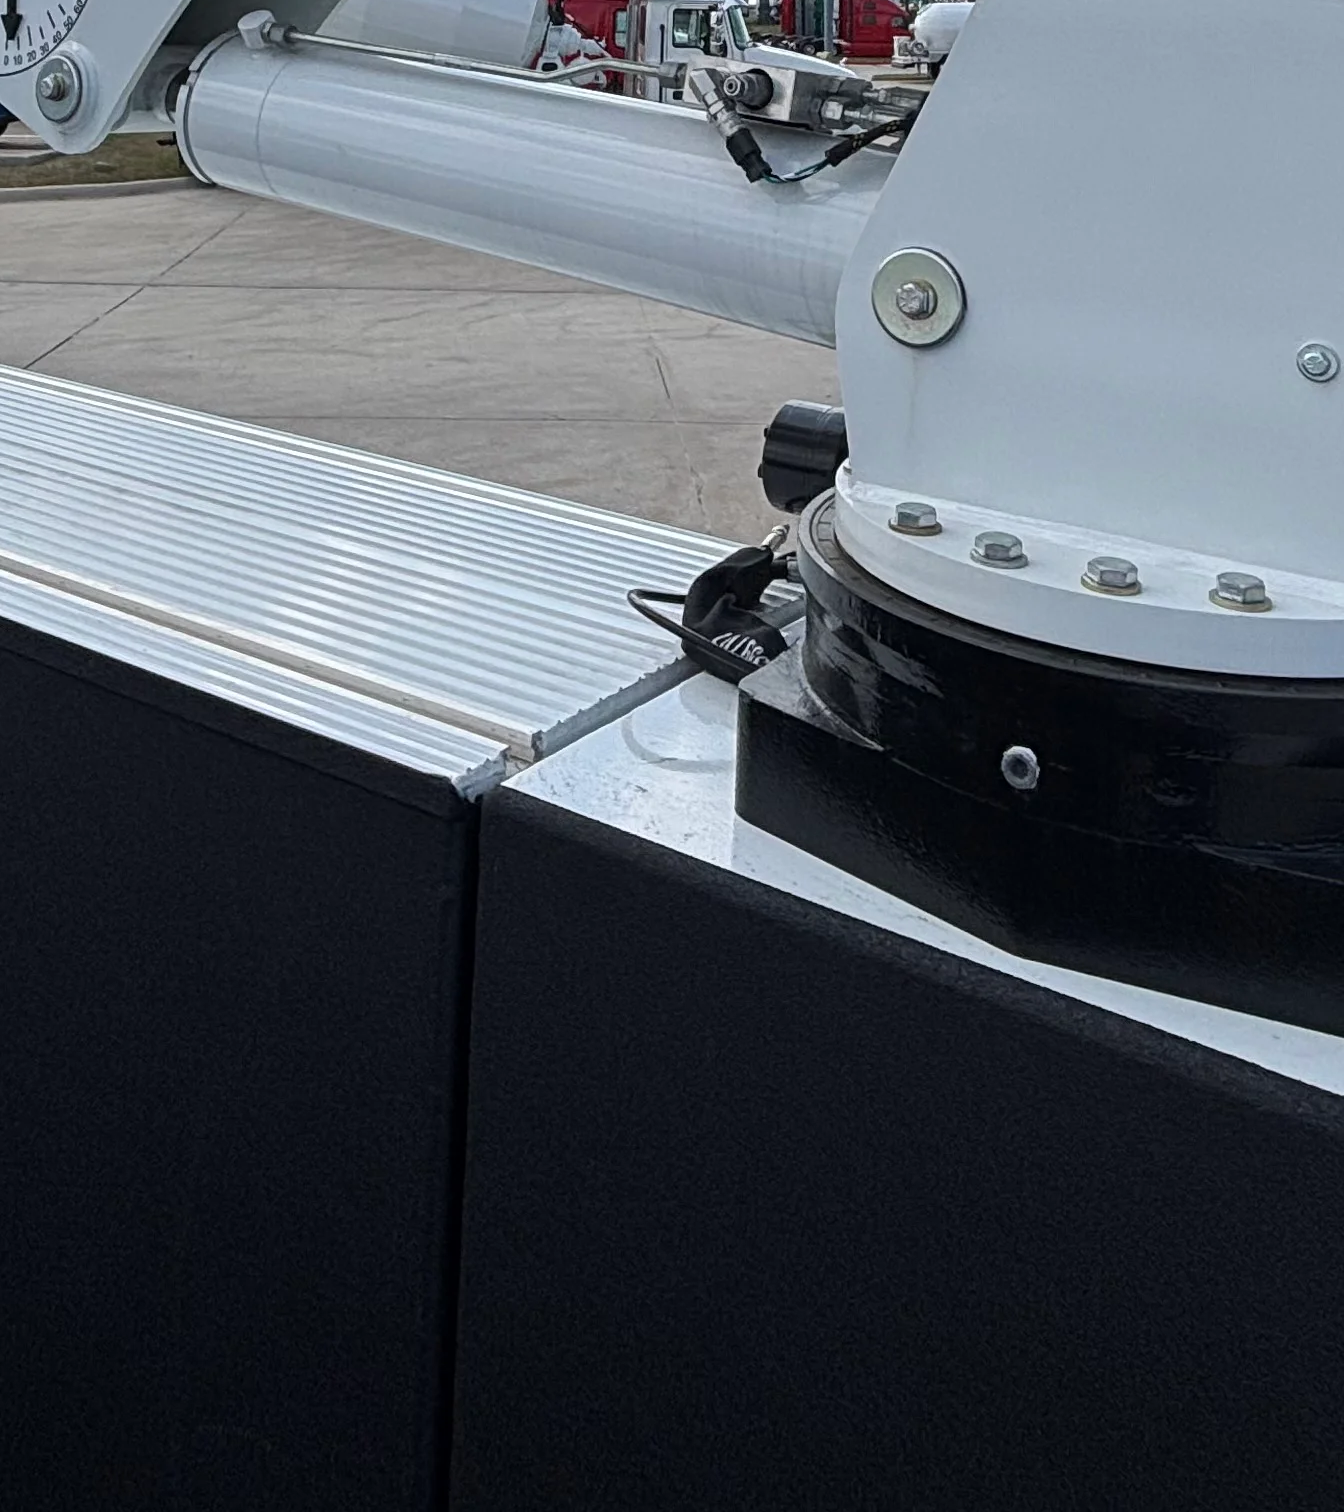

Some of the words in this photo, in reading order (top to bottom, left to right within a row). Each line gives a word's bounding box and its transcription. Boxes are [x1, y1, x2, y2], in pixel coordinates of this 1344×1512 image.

[73, 0, 84, 14] 60
[63, 16, 74, 31] 50
[52, 30, 62, 44] 40
[27, 50, 37, 62] 20
[40, 42, 50, 56] 30
[3, 54, 9, 66] 0
[13, 54, 23, 66] 10
